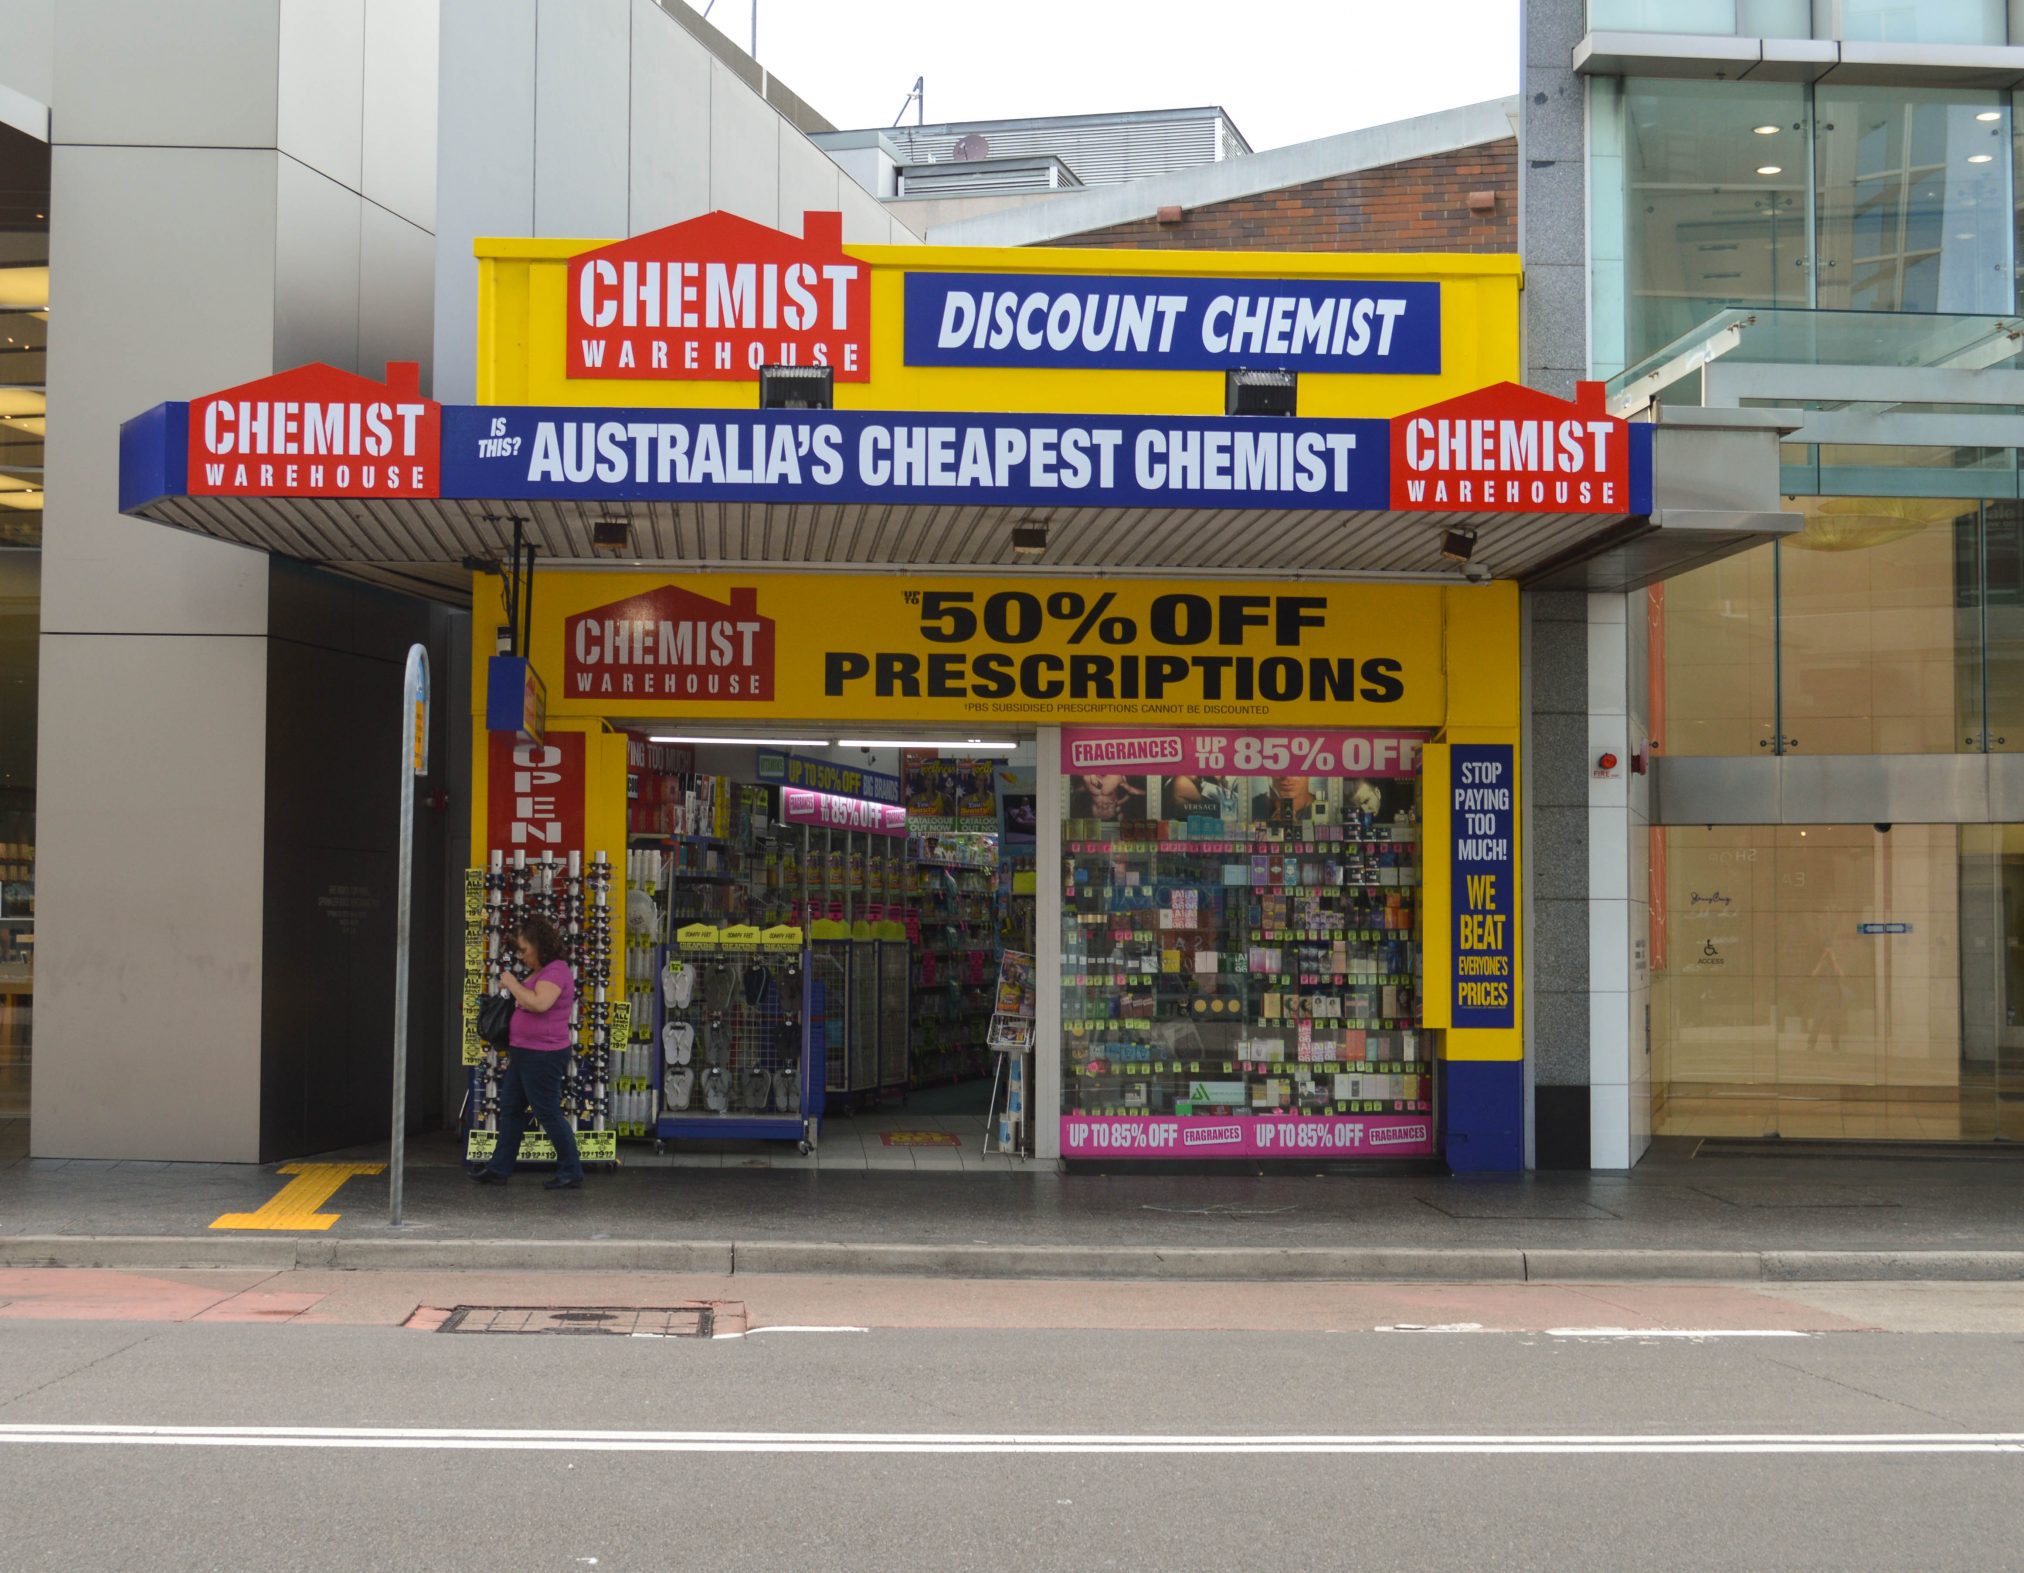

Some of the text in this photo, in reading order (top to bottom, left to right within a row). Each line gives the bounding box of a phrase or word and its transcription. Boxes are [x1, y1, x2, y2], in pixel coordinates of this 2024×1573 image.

[579, 259, 858, 331] CHEMIST
[937, 290, 1407, 357] DISCOUNT CHEMIST
[582, 338, 858, 372] WAREHOUSE
[204, 399, 425, 457] CHEMIST
[490, 417, 506, 437] IS
[478, 436, 522, 459] THIS?
[527, 421, 1357, 493] AUSTRALIA'S CHEAPEST CHEMIST
[1405, 418, 1614, 473] CHEMIST
[205, 463, 424, 489] WAREHOUSE
[1407, 480, 1614, 504] WAREHOUSE
[920, 591, 1328, 647] 50% OFF
[575, 618, 761, 667] CHEMIST
[576, 672, 760, 694] WAREHOUSE
[824, 652, 1405, 704] PRESCRIPTIONS
[992, 703, 1054, 713] SUBSIDISED
[1057, 703, 1138, 713] PRESCRIPTIONS
[1141, 704, 1184, 714] CANNOT
[1186, 704, 1201, 714] BE
[1203, 704, 1270, 715] DISCOUNTED
[1075, 739, 1179, 762] FRAGRANCES
[1195, 736, 1228, 752] UP
[1233, 736, 1335, 771] 85%
[1194, 752, 1225, 769] TO
[788, 759, 803, 783] UP
[803, 762, 817, 786] TO
[842, 770, 862, 793] OFF
[1461, 762, 1502, 784] STOP
[831, 794, 882, 829] 85% OFF
[1455, 788, 1510, 811] PAYING
[910, 824, 952, 832] OUT NOW
[1465, 813, 1496, 836] TOO
[1458, 839, 1507, 861] MUCH!
[1466, 874, 1496, 911] WE
[1460, 914, 1506, 950] BEAT
[1458, 956, 1508, 976] EVERYONE'S
[1697, 957, 1724, 965] ACCESS
[1458, 982, 1508, 1006] PRICES
[1069, 1123, 1179, 1148] UP TO 85% OFF
[1184, 1128, 1241, 1143] FRAGRANCES
[1256, 1123, 1364, 1148] UP TO 85% OFF
[1370, 1128, 1426, 1143] FRAGRANCES
